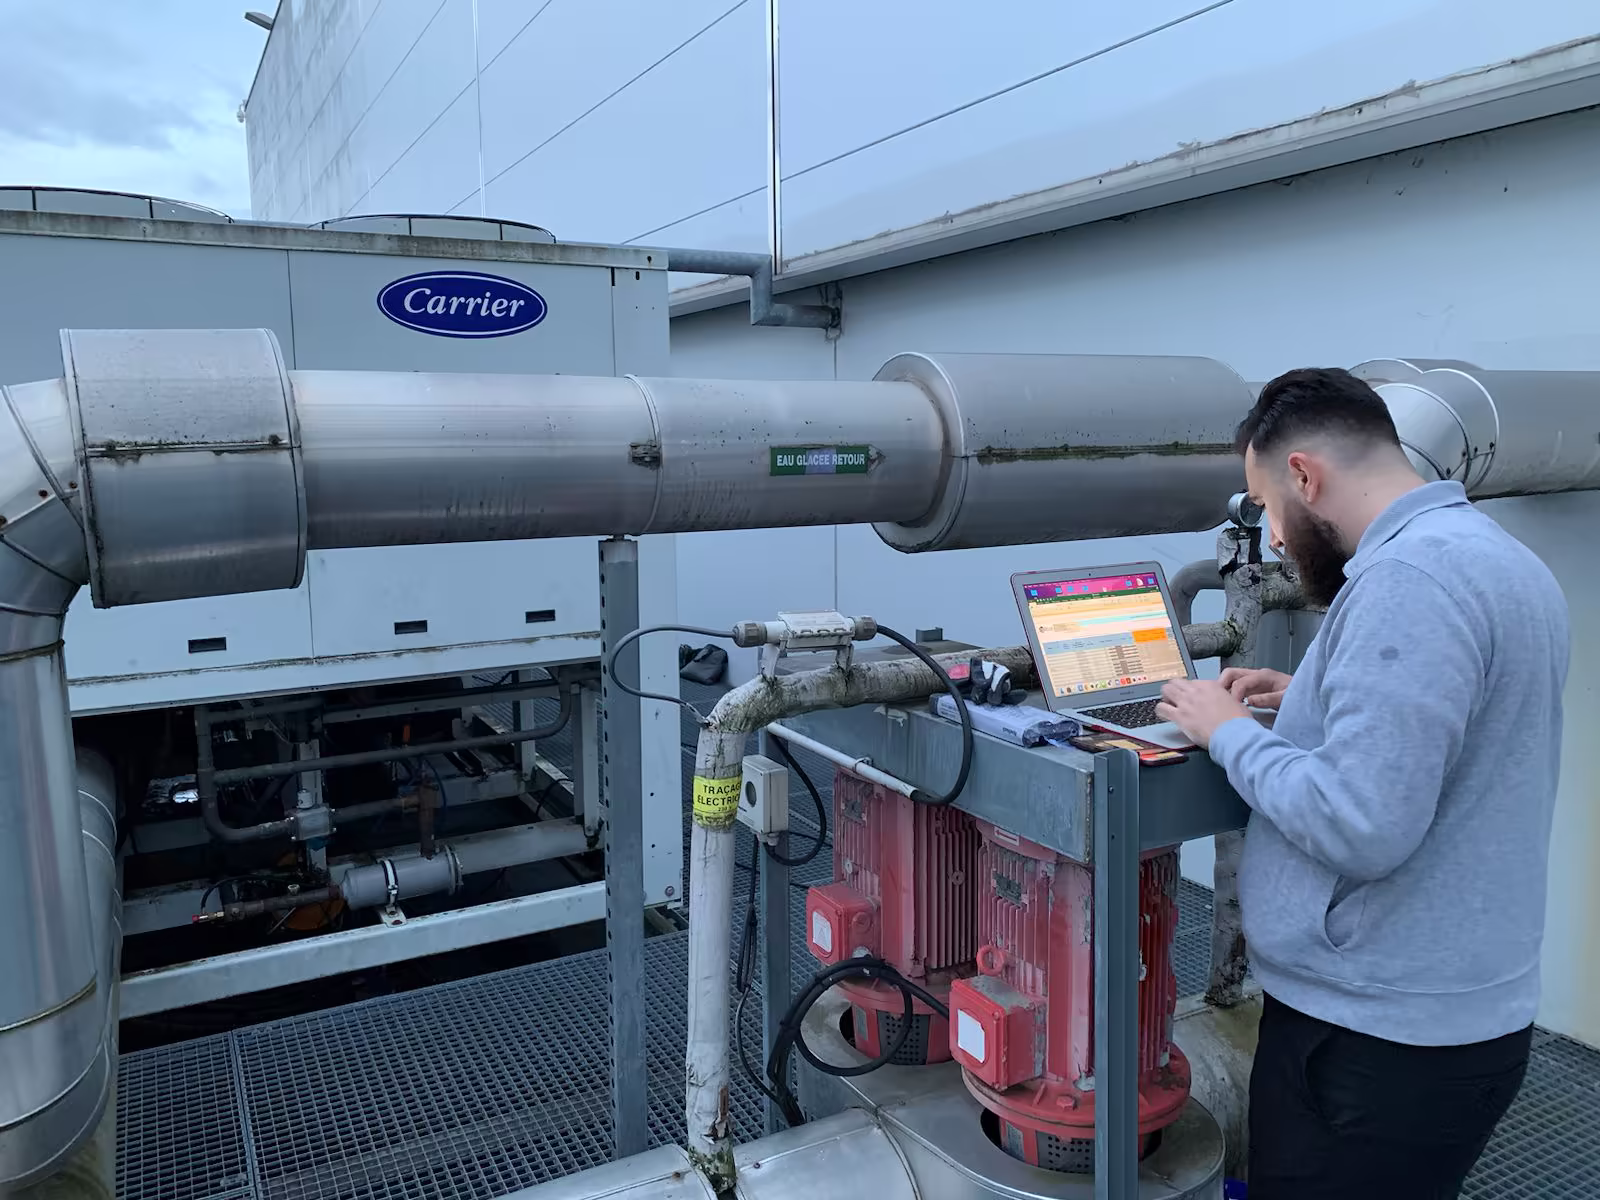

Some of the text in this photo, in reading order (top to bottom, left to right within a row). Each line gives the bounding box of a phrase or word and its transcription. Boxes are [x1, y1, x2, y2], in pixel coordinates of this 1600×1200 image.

[404, 288, 525, 317] Carrier
[776, 453, 865, 467] EAU GLACEE RETOUR
